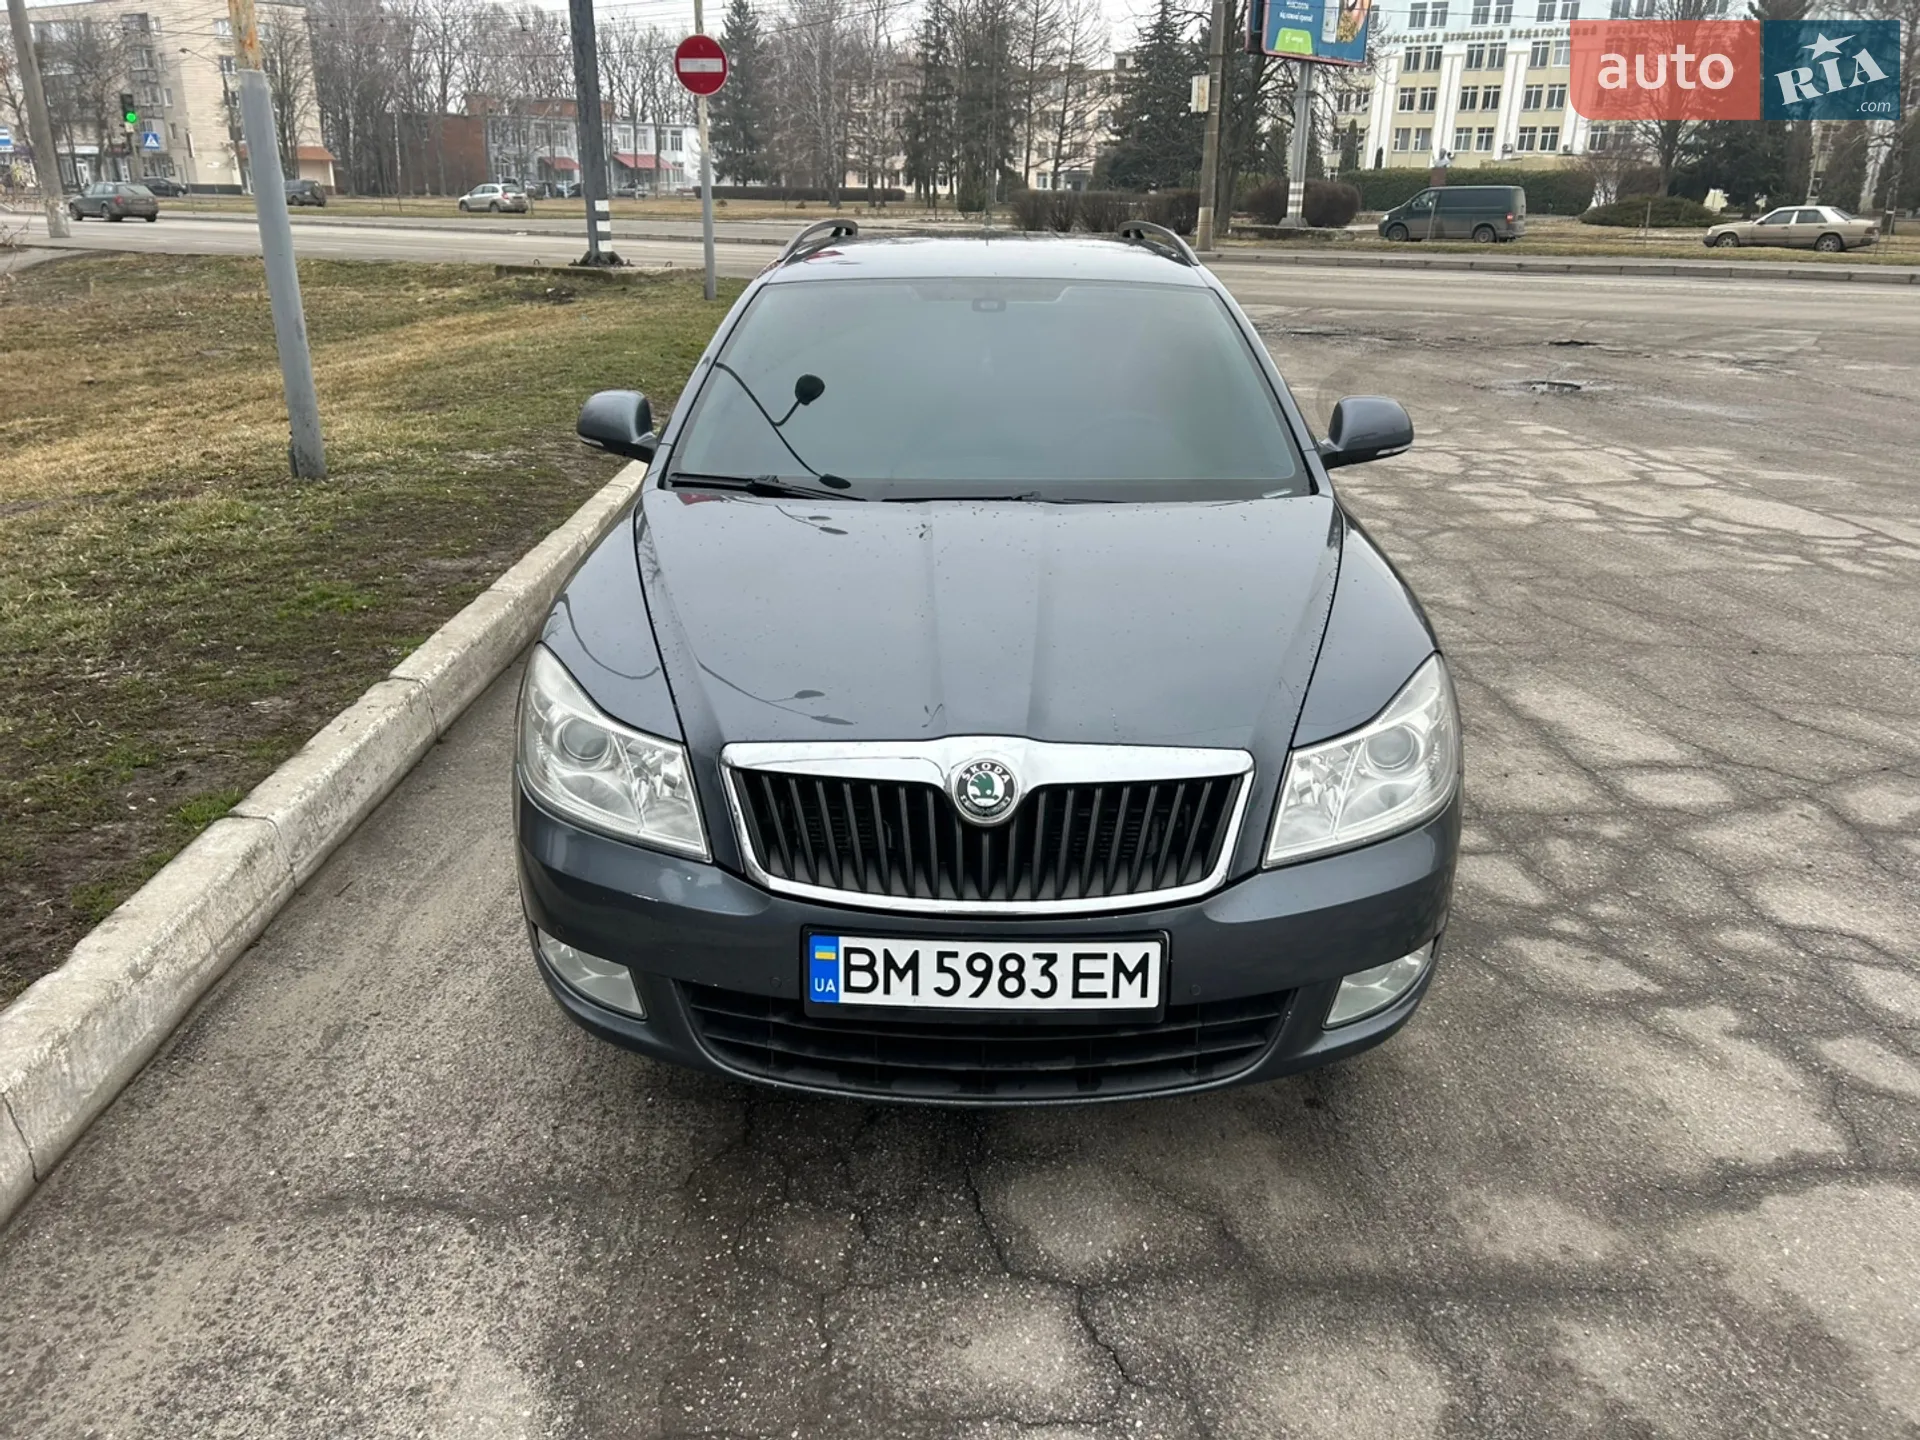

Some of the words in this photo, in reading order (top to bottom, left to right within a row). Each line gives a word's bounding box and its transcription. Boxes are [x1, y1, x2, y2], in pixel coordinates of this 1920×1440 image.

[814, 979, 836, 993] UA
[843, 947, 919, 996] BM
[933, 951, 1058, 999] 5983
[1072, 952, 1149, 999] EM
